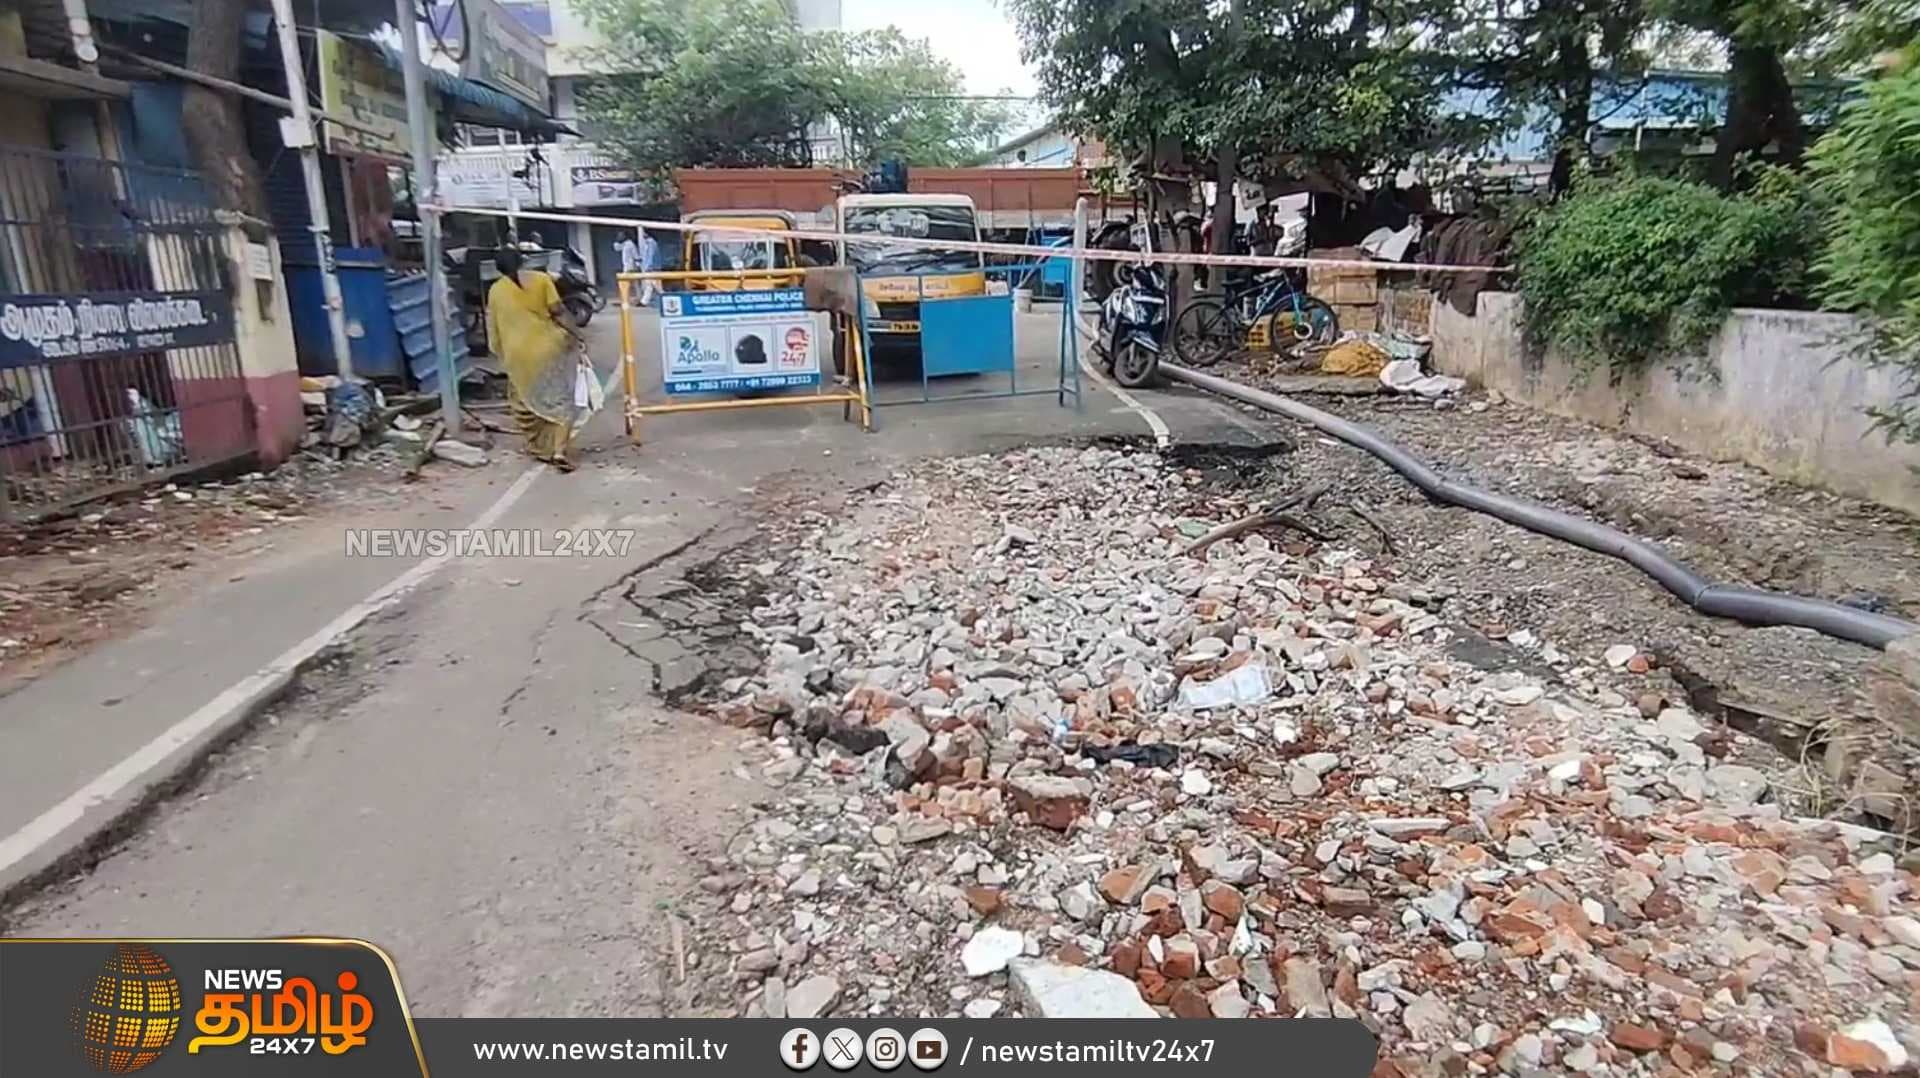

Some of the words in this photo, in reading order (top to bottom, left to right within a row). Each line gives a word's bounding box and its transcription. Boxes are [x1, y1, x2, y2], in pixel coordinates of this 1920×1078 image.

[692, 294, 733, 304] GREATER
[774, 291, 804, 302] POLICE
[677, 350, 720, 364] Apollo
